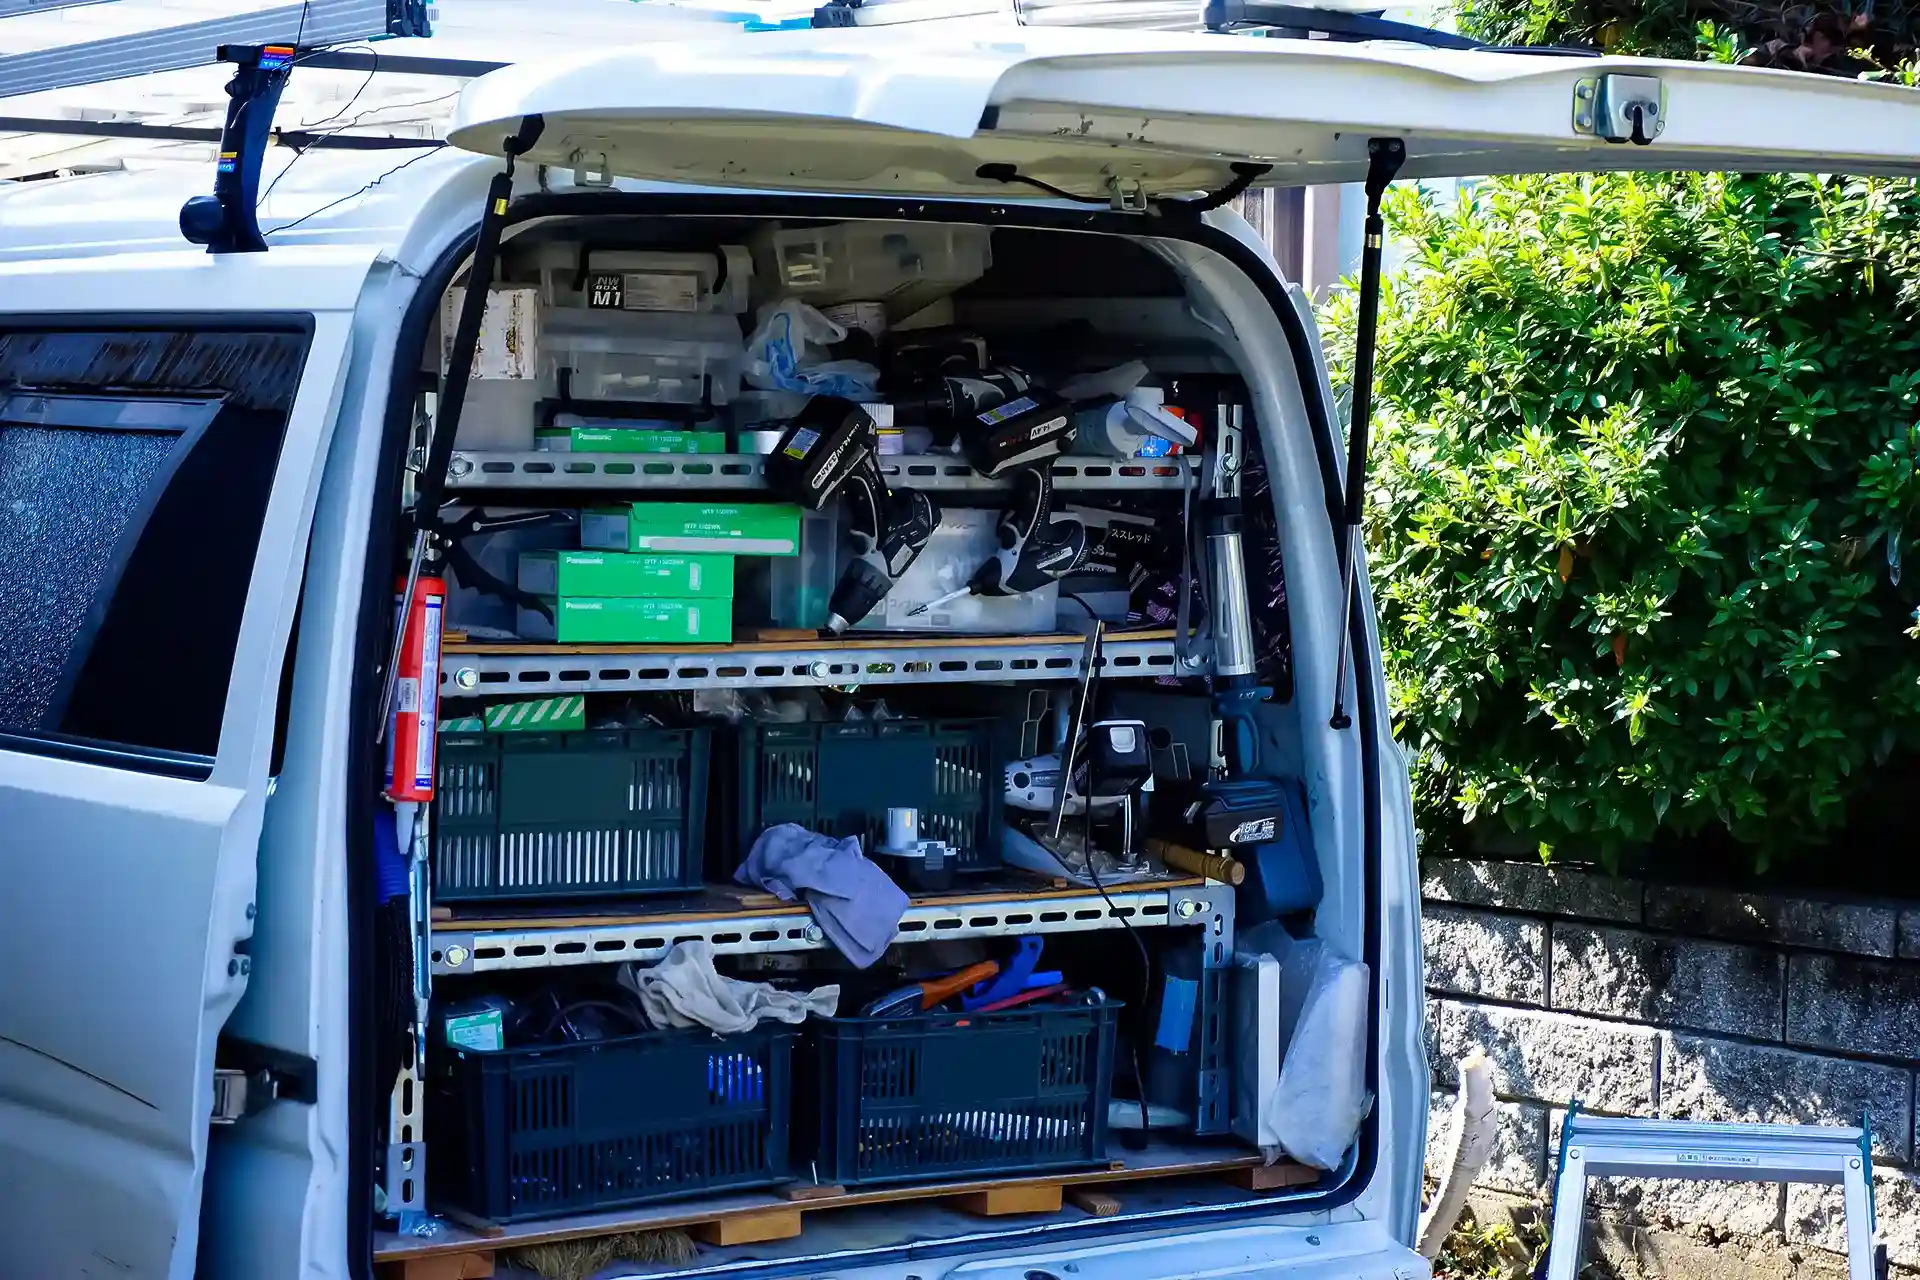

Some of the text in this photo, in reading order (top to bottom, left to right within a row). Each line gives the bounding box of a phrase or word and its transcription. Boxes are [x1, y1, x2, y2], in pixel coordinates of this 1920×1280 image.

[597, 276, 619, 285] NW
[593, 291, 621, 306] M1
[1031, 424, 1050, 437] 14.4V
[578, 432, 612, 441] Panasonic
[566, 557, 604, 565] Panasonic
[1239, 821, 1261, 833] 18V
